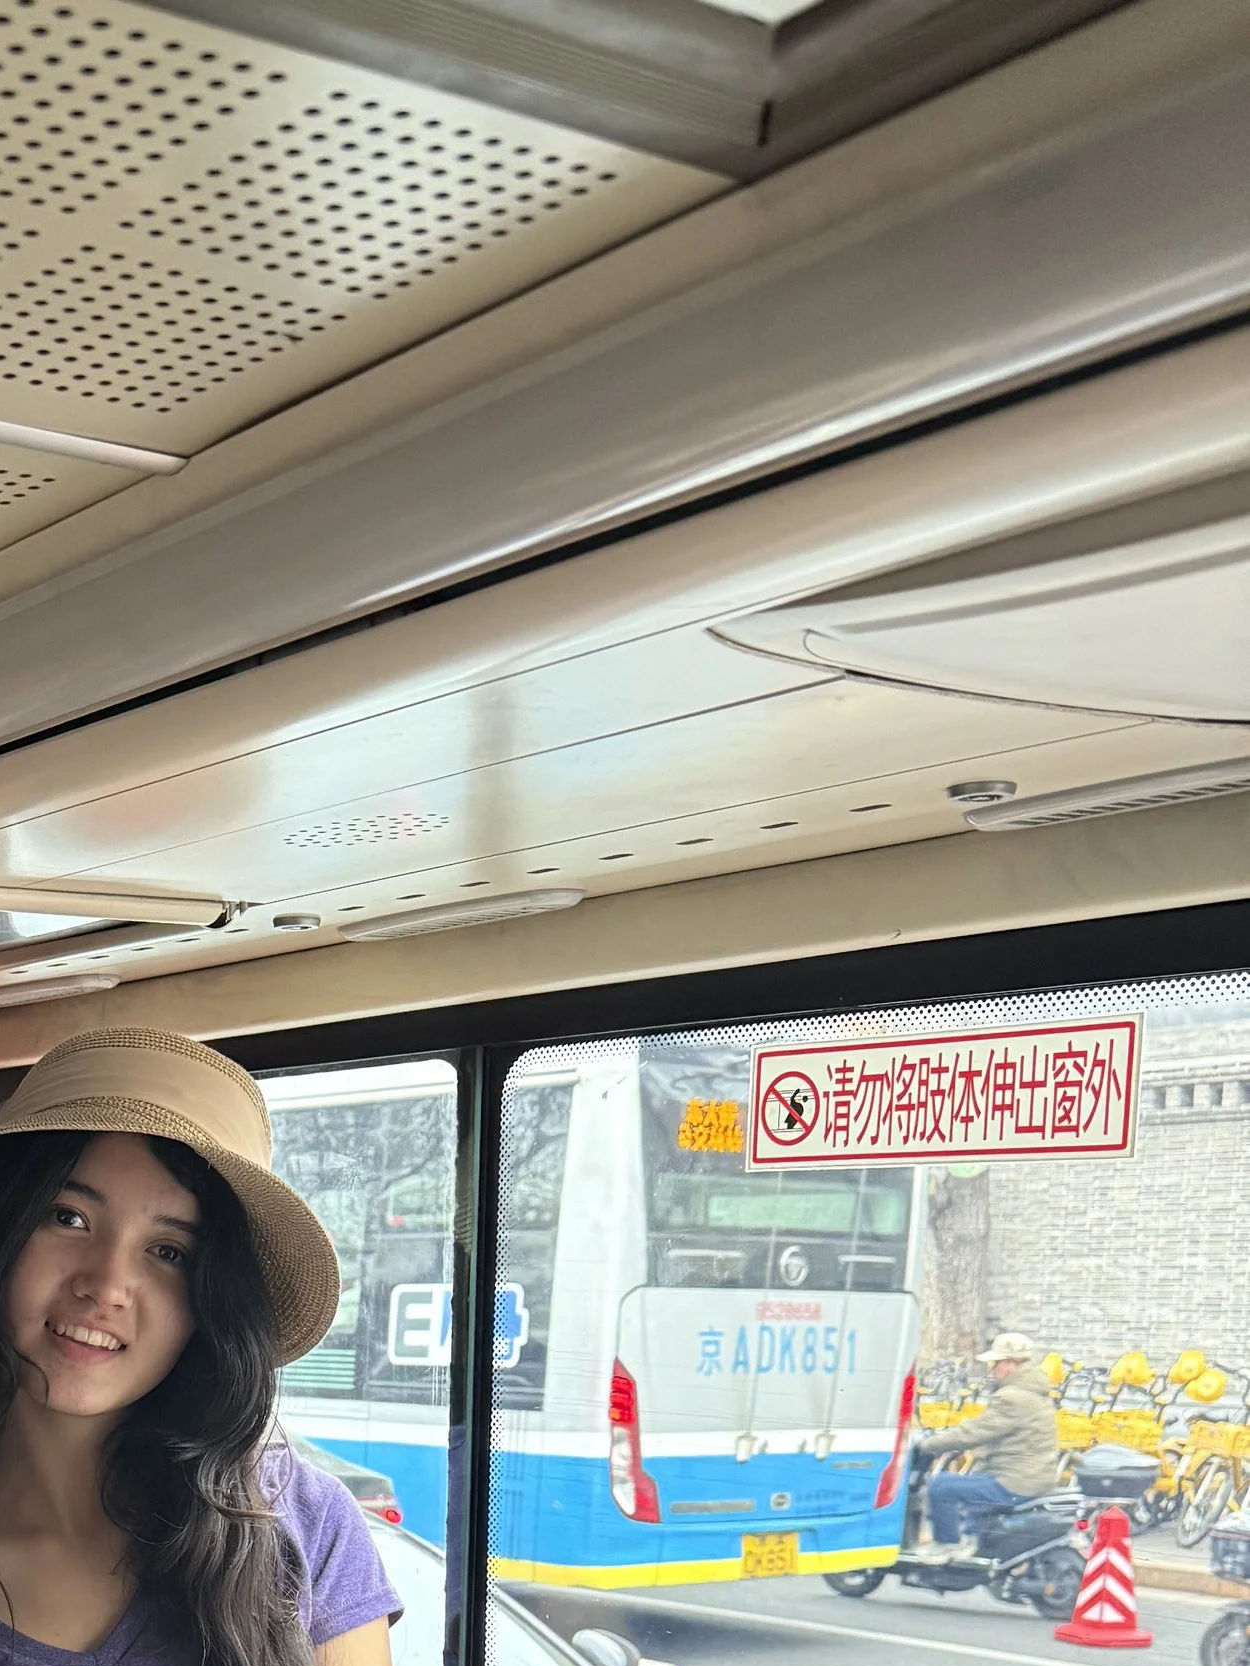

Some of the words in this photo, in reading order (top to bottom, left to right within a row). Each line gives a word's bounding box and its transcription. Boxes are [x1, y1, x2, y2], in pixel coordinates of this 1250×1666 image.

[822, 1038, 1122, 1148] 请勿将肢体伸出窗外
